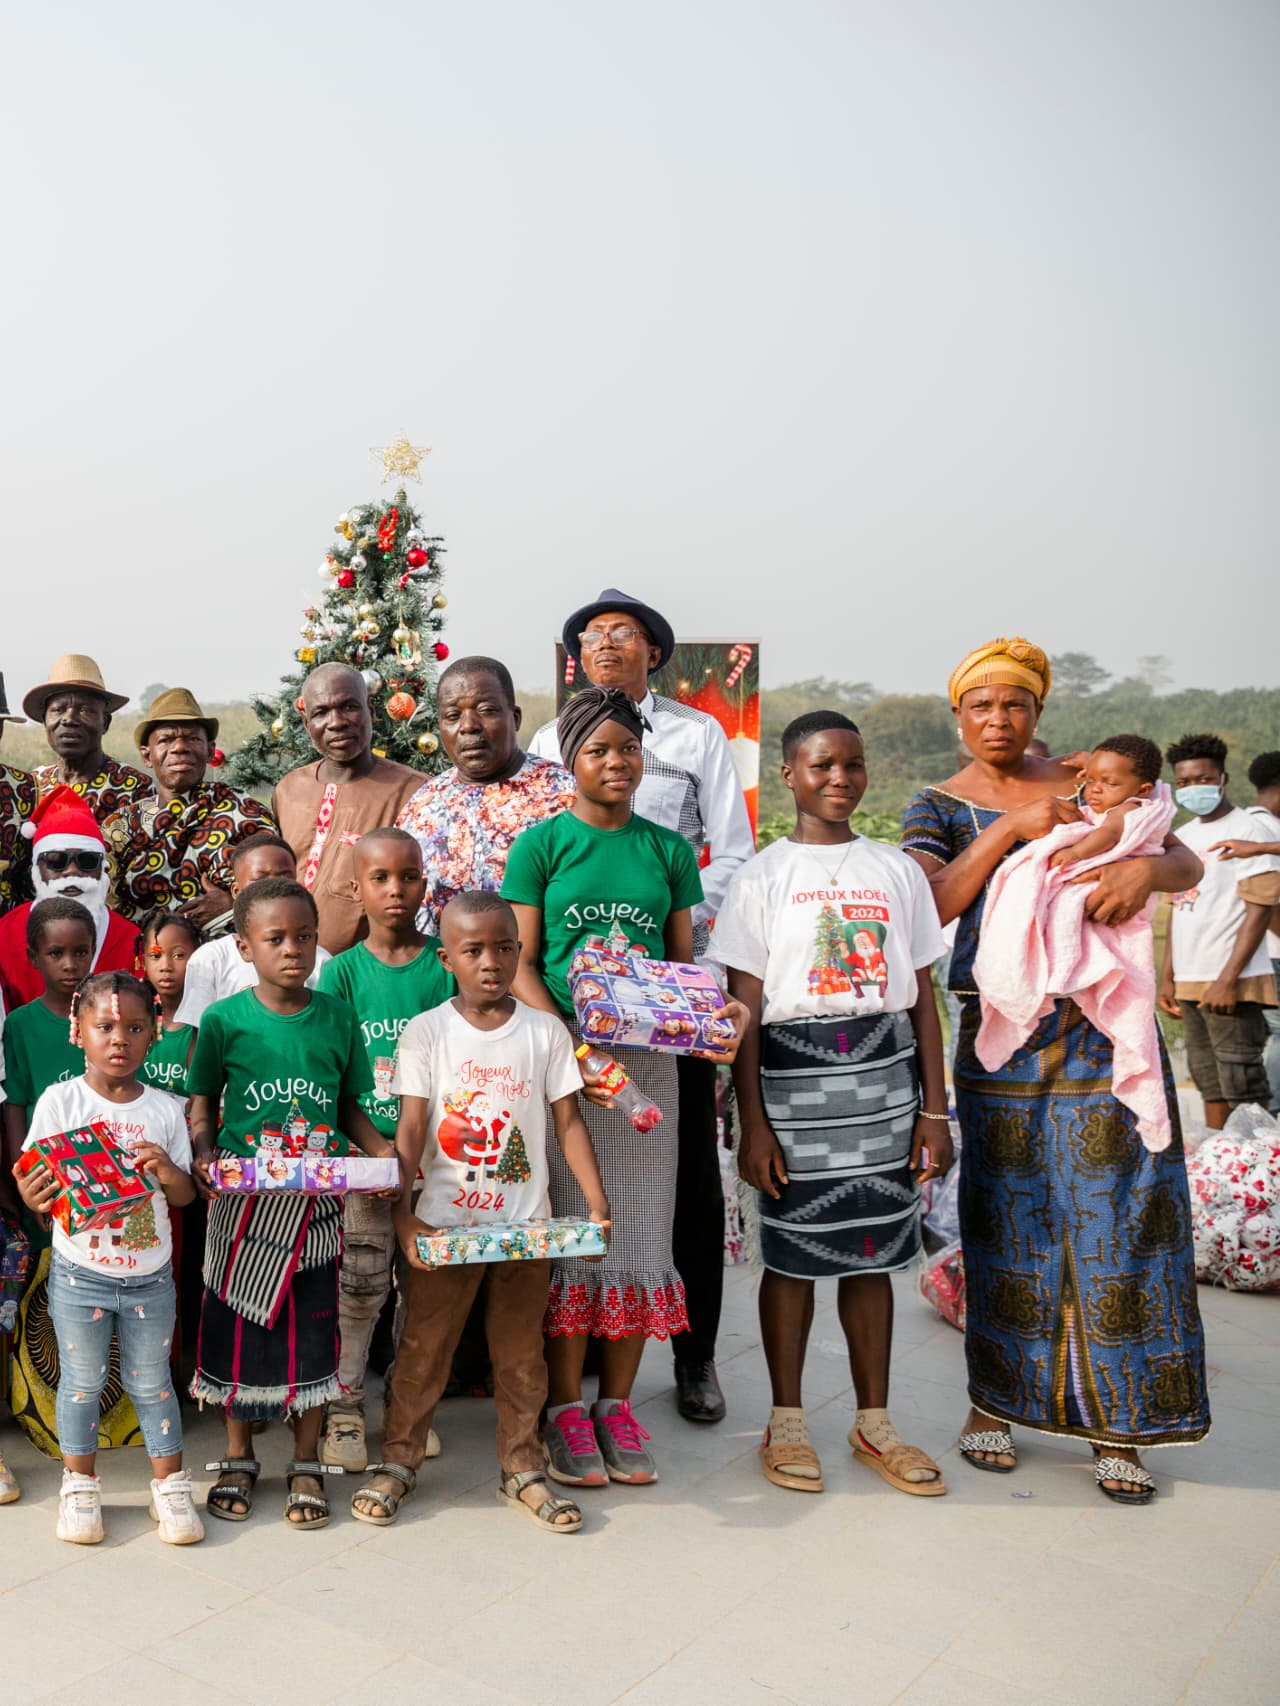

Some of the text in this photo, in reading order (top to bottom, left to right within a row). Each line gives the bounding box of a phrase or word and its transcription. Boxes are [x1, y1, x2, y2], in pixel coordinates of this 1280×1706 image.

[792, 889, 890, 904] JOYEUX NOËL
[564, 902, 657, 934] Joyeux
[849, 907, 884, 919] 2024
[360, 1018, 410, 1047] Joye
[460, 1059, 515, 1088] Joyeux
[243, 1077, 333, 1112] Joyeux
[452, 1188, 505, 1212] 2024
